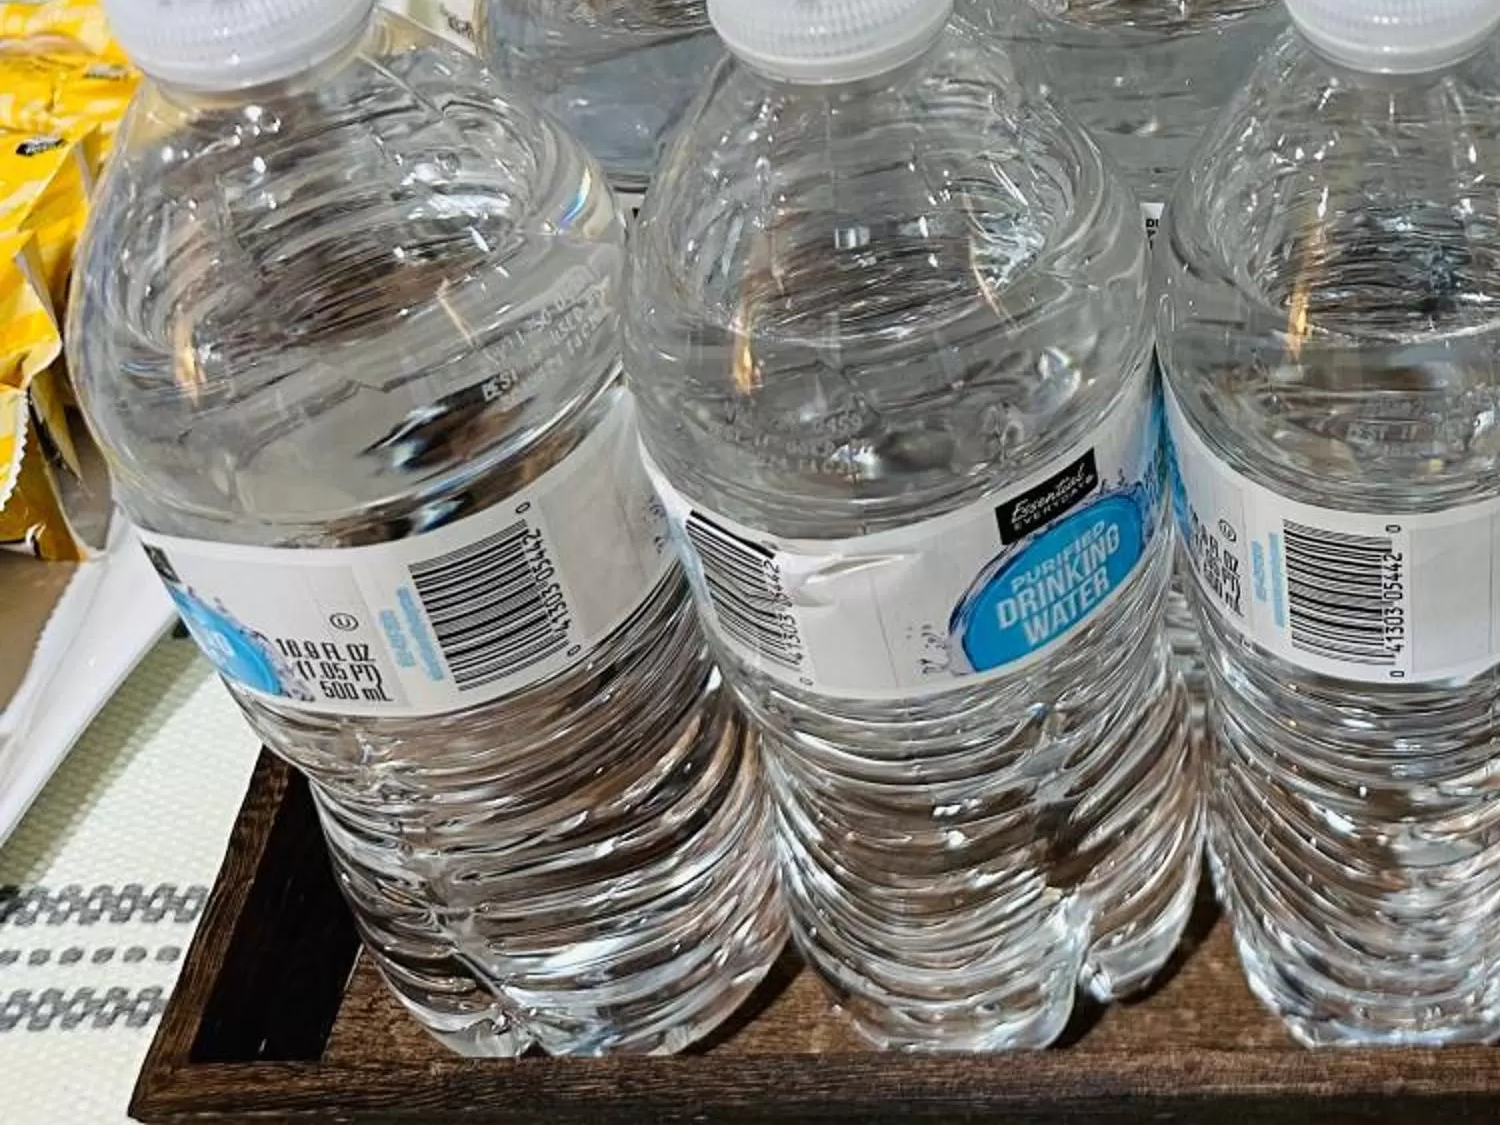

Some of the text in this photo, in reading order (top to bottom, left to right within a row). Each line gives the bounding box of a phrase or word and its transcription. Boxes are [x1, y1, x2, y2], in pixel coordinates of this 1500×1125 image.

[996, 522, 1121, 630] DRINKING
[1010, 520, 1105, 593] PURIFIED
[1383, 552, 1403, 601] 05442
[1023, 566, 1110, 647] WATER
[1383, 606, 1405, 653] 41303
[346, 643, 376, 662] OZ
[319, 680, 360, 700] 500
